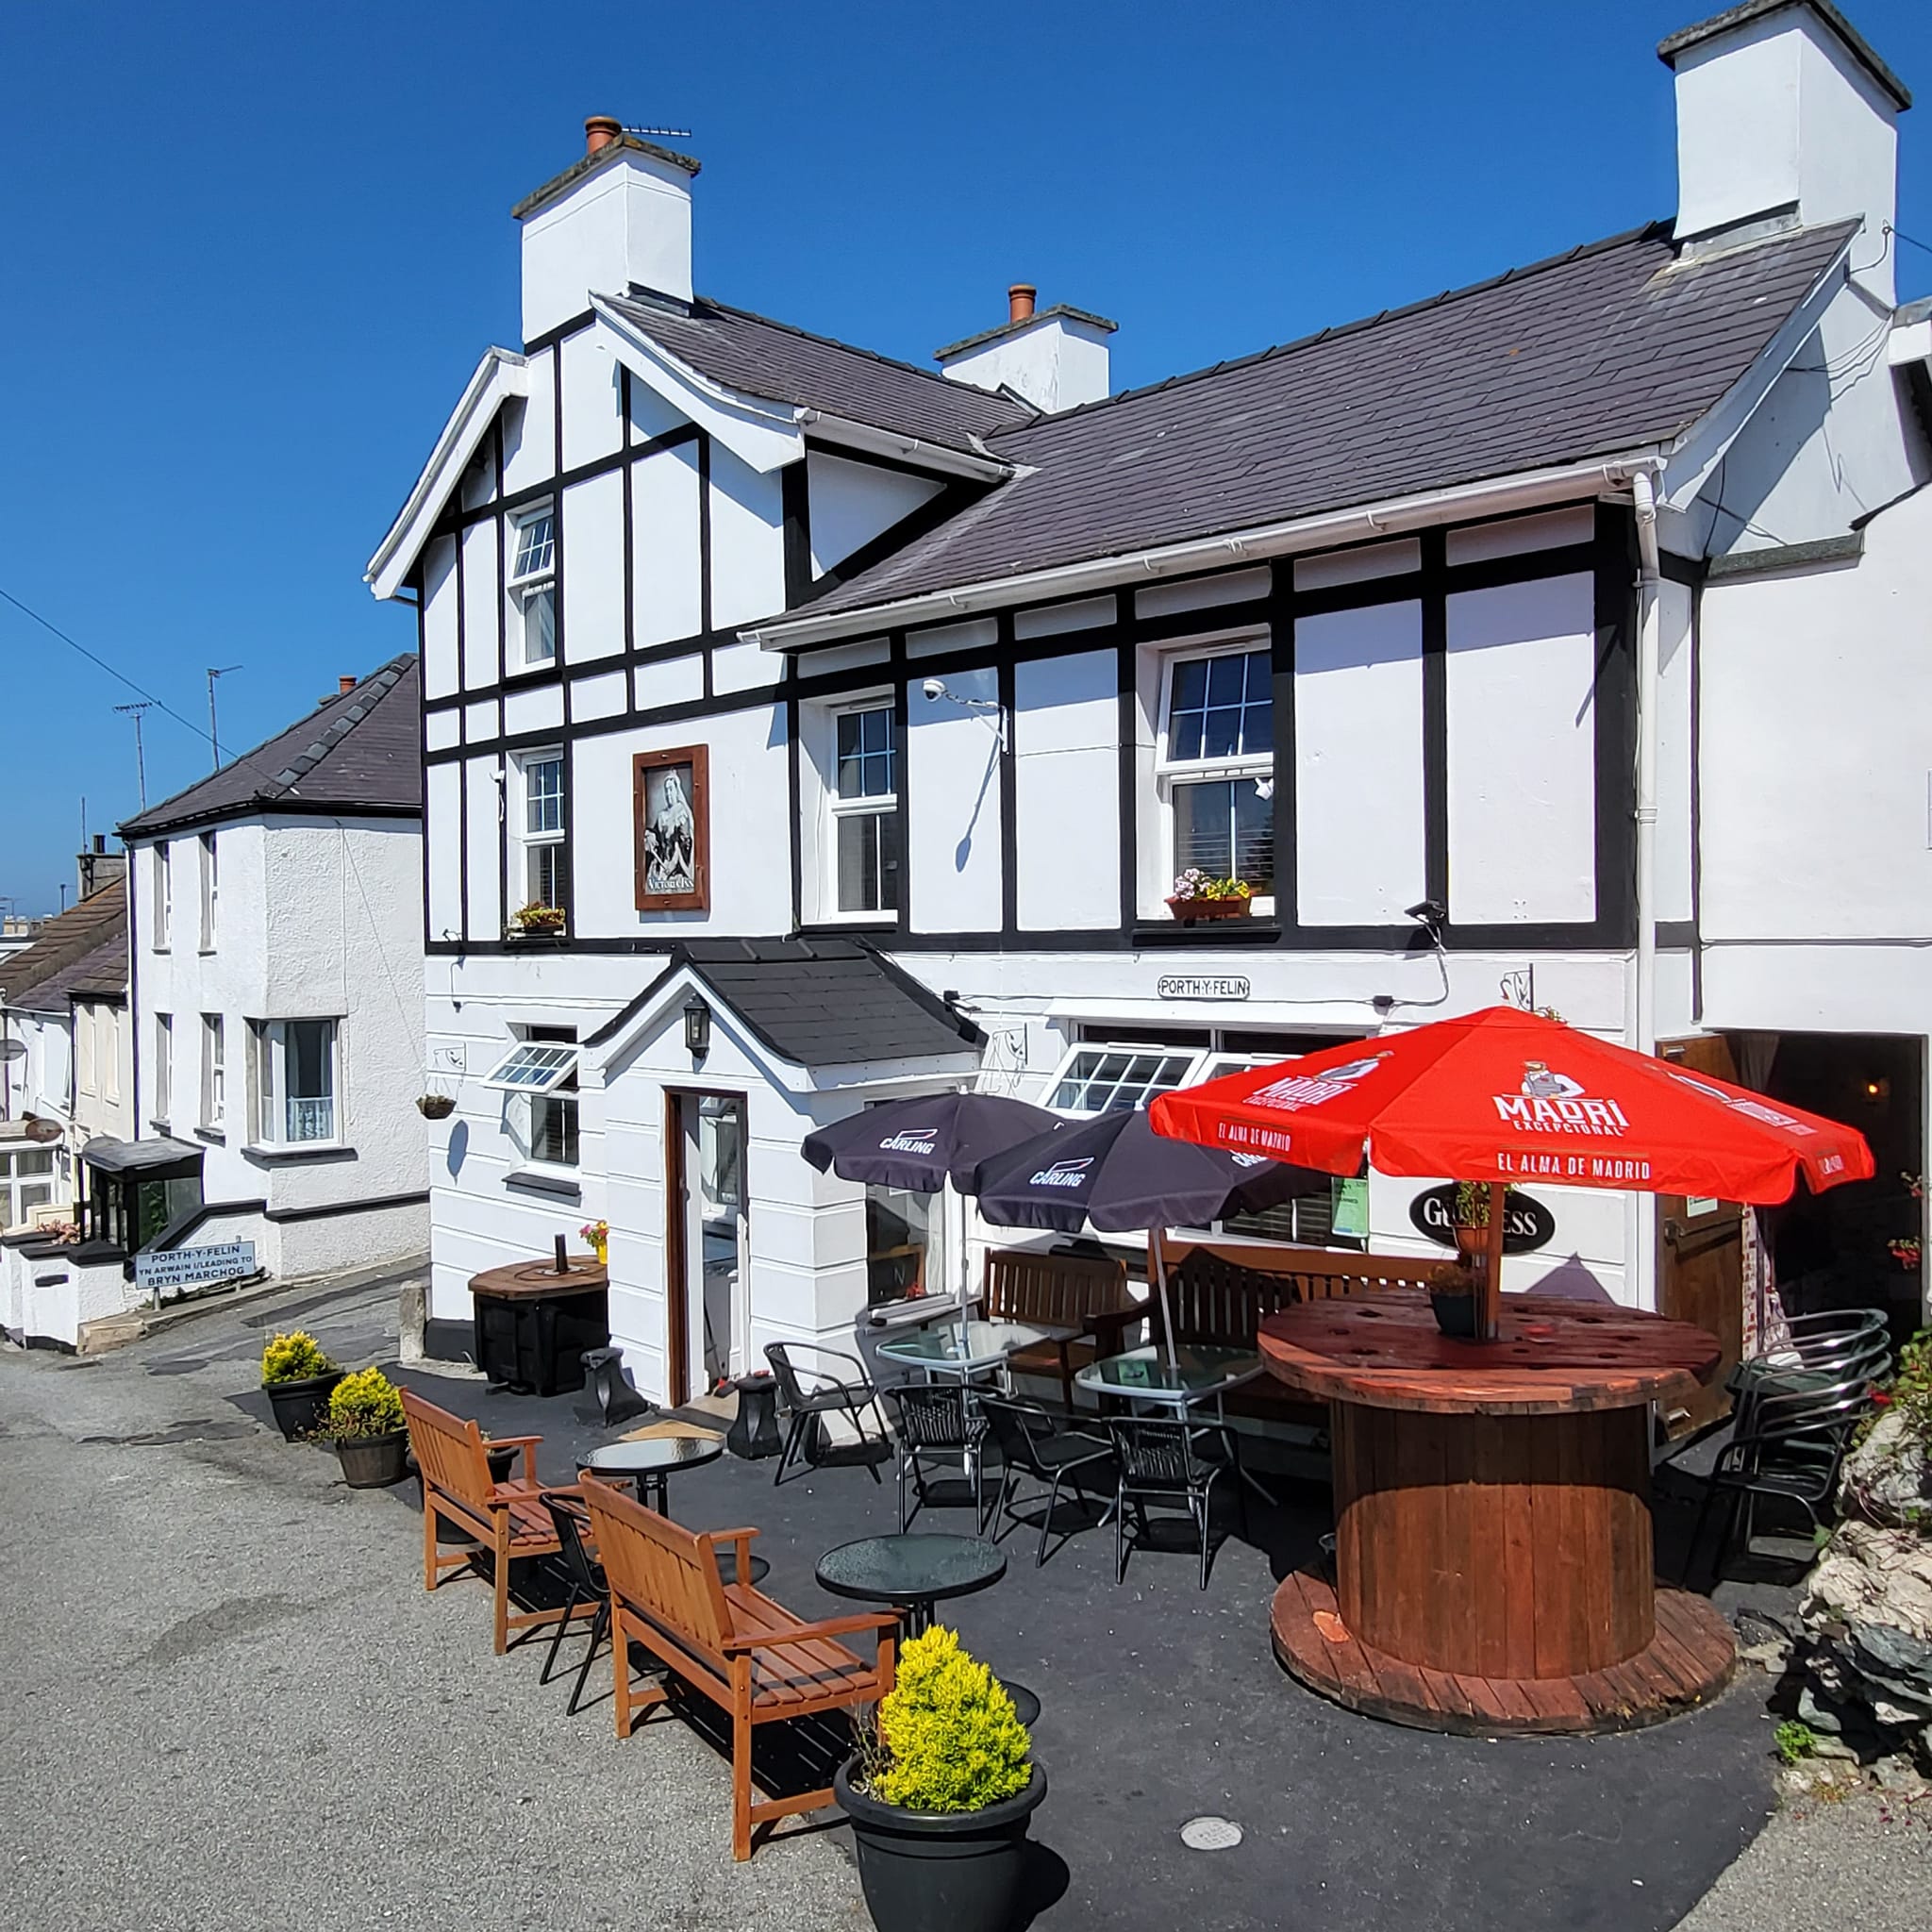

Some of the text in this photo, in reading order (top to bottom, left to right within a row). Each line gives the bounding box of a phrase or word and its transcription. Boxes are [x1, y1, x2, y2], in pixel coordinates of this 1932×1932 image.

[1218, 1122, 1226, 1140] EL
[1228, 1124, 1248, 1141] ALMA
[1512, 1120, 1624, 1138] EXCEPCIONAL
[879, 1138, 936, 1155] CARLING
[1498, 1153, 1650, 1179] EL ALMA DE MADRID
[1029, 1170, 1086, 1187] CARLING
[151, 1245, 241, 1263] PORTH-Y-FELIN
[147, 1266, 244, 1287] BRYN MARCHOG
[155, 1263, 192, 1274] ARWAIN
